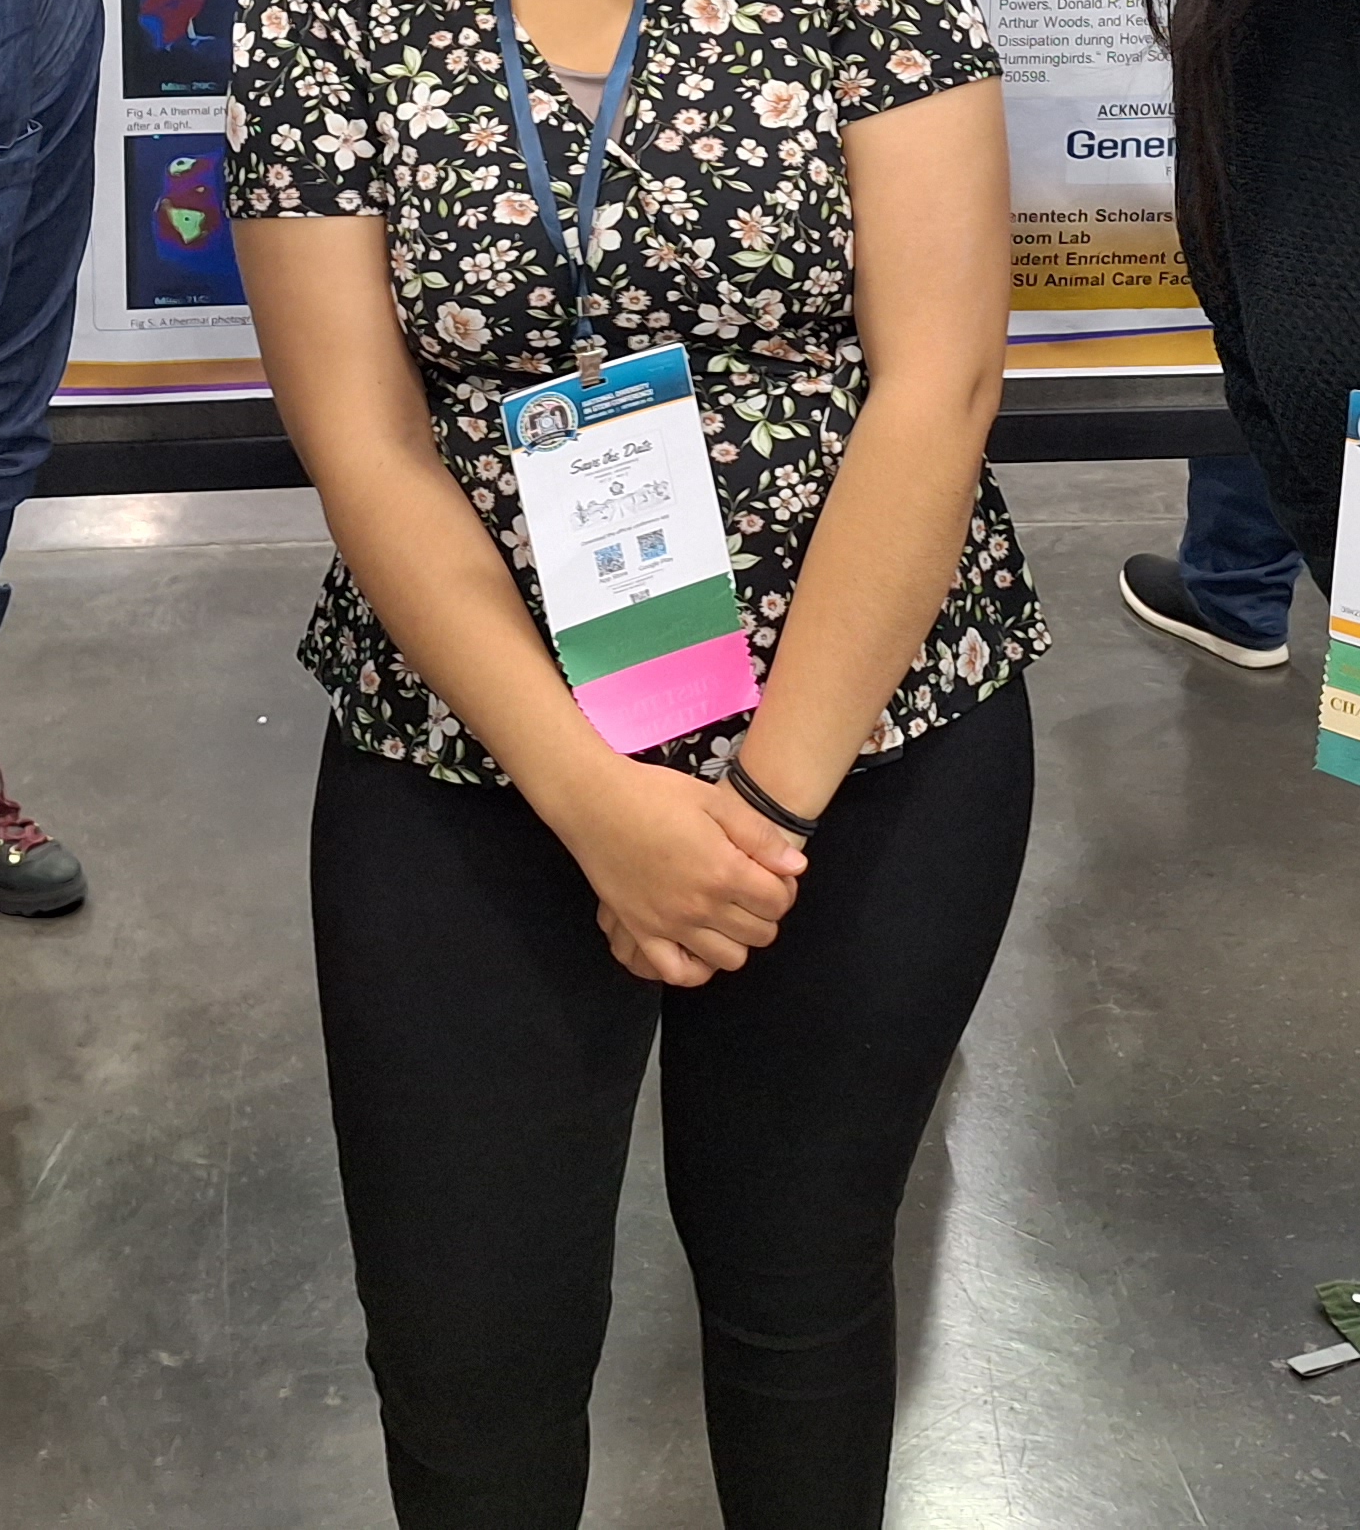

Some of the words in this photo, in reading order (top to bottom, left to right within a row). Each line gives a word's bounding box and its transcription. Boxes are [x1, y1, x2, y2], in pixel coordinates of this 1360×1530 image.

[998, 16, 1039, 29] Arthur
[1043, 16, 1094, 30] Woods,
[998, 34, 1069, 50] Dissipation
[1095, 209, 1173, 224] Scholars
[1058, 230, 1091, 245] Lab
[1066, 251, 1167, 266] Enrichment
[1044, 272, 1105, 287] Animal
[1112, 272, 1152, 286] Care
